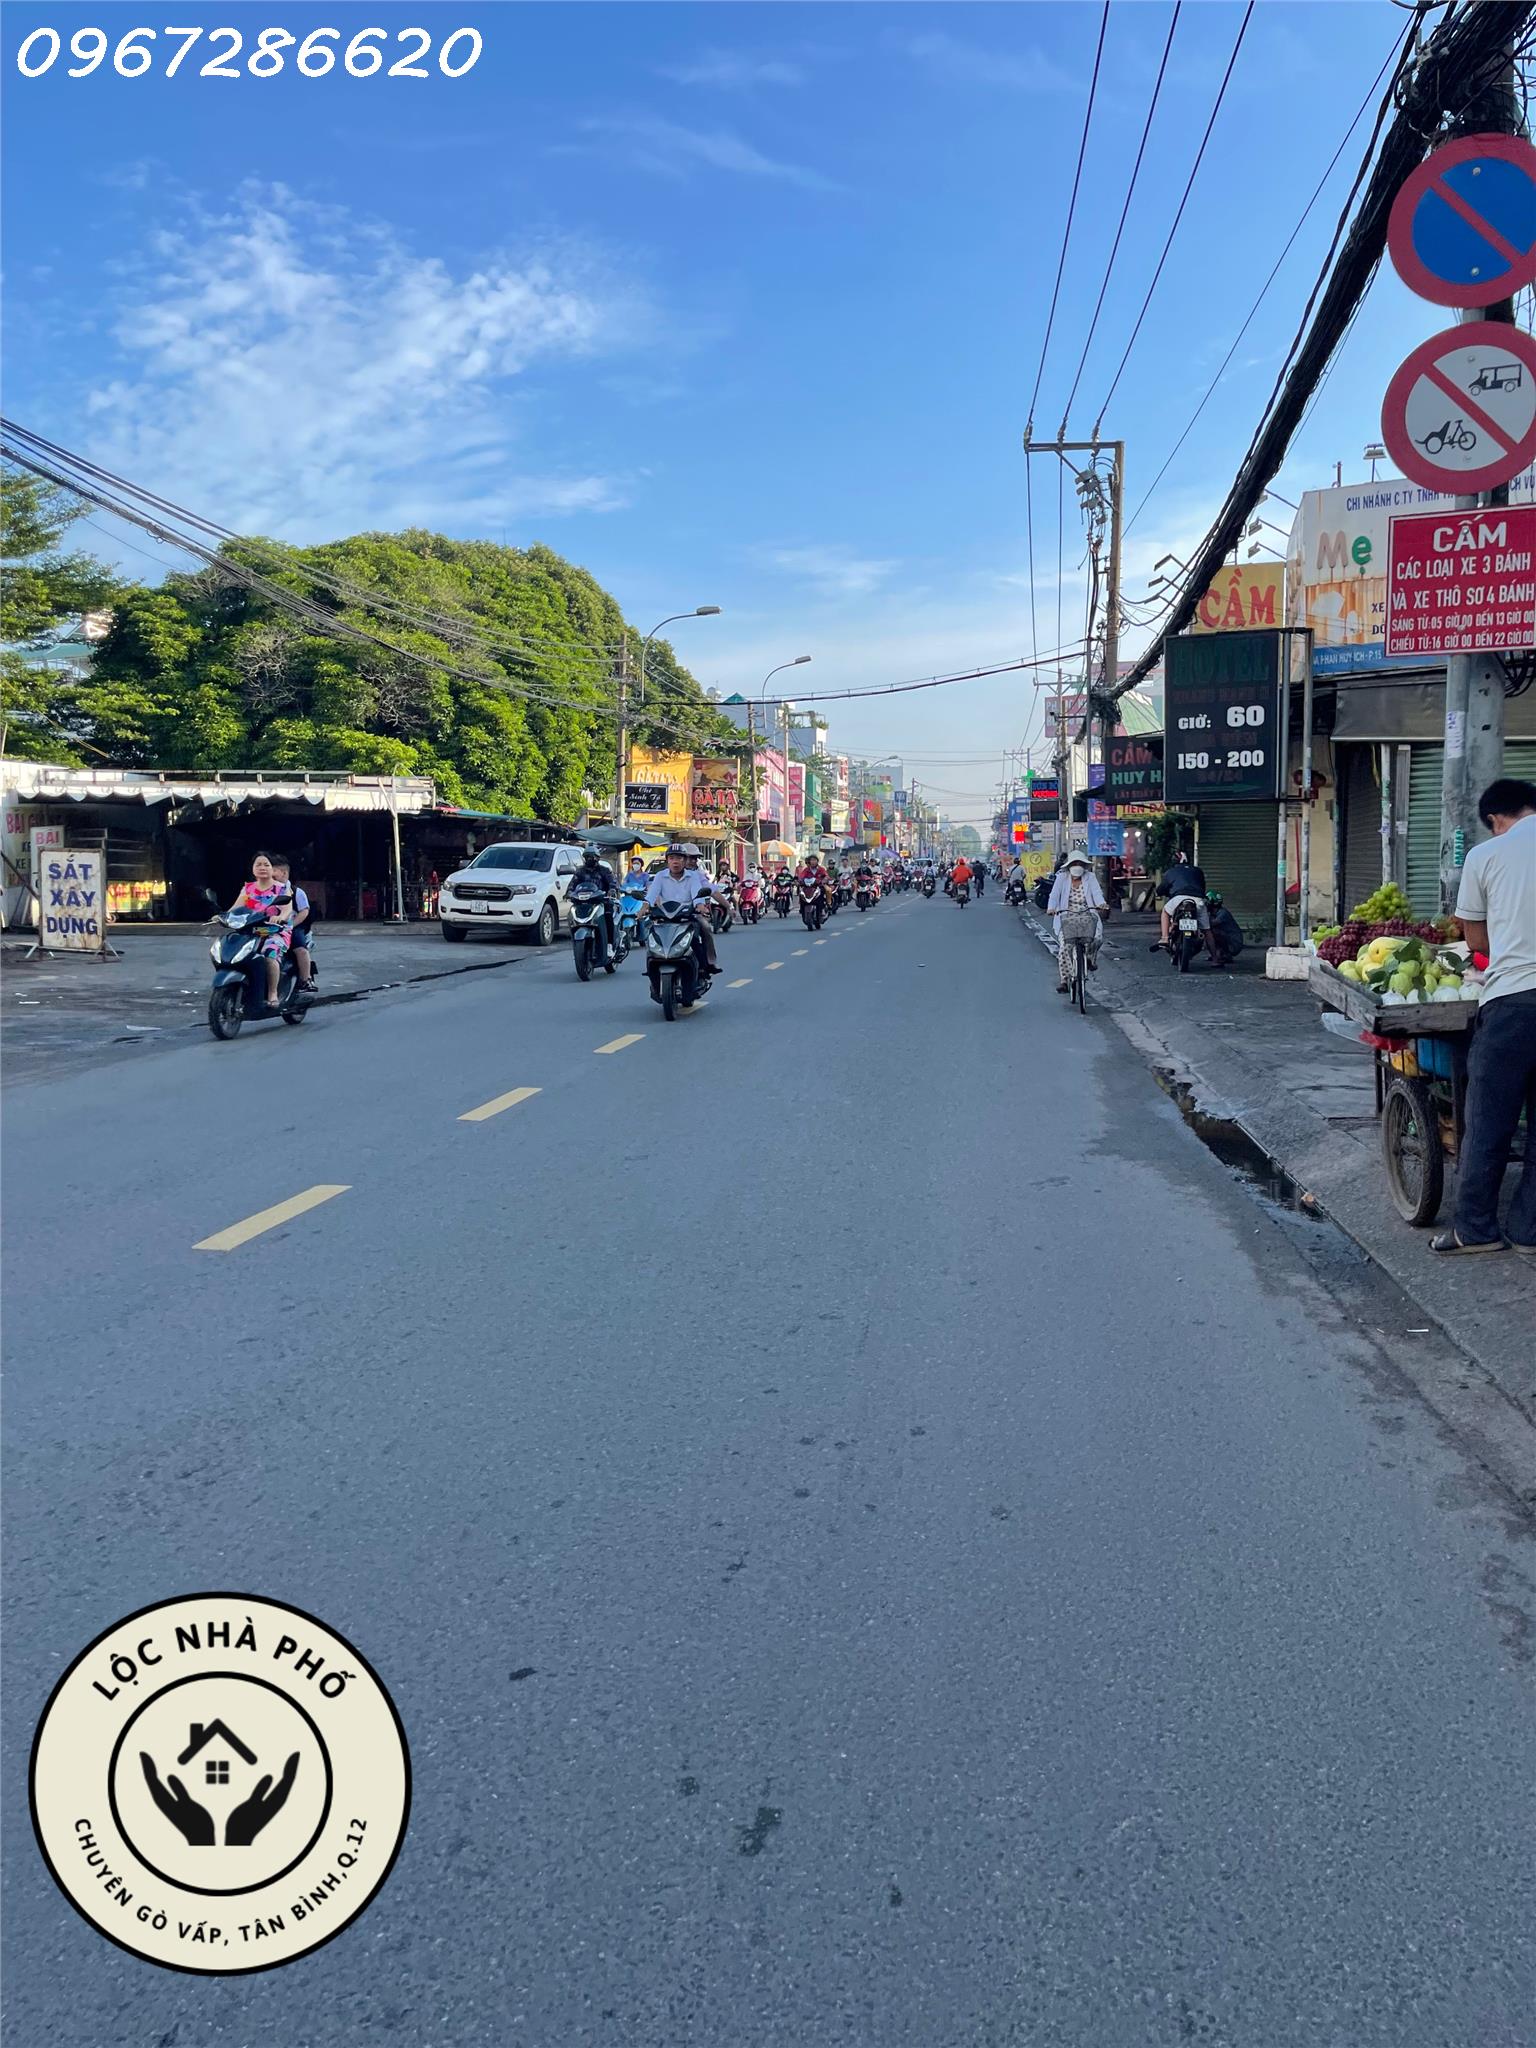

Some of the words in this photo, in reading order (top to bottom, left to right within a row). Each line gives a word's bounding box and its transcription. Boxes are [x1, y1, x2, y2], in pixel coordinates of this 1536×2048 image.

[1346, 497, 1361, 511] CHI
[1363, 491, 1391, 509] NHÁNH
[1432, 513, 1508, 553] CẤM
[1317, 530, 1373, 575] Mẹ
[1397, 556, 1421, 580] CÁC
[1426, 558, 1454, 580] LOẠI
[1461, 556, 1477, 575] XE
[1482, 555, 1491, 574] 3
[1495, 548, 1531, 573] BÁNH
[1199, 568, 1276, 628] CẦM
[1392, 587, 1407, 610] VÀ
[1413, 590, 1430, 609] XE
[1436, 584, 1461, 608] THÔ
[1466, 586, 1485, 606] SƠ
[1486, 585, 1495, 604] 4
[1499, 578, 1535, 603] BÁNH
[1391, 613, 1414, 632] SÁNG
[1495, 611, 1505, 625] 13
[1507, 607, 1522, 624] GIỜ
[1523, 609, 1535, 623] 00
[1444, 631, 1461, 648] GIỜ
[1461, 634, 1473, 647] 00
[1494, 630, 1506, 645] 22
[1507, 628, 1521, 644] GIỜ
[1523, 630, 1534, 643] 00
[1173, 638, 1269, 686] HOTEL
[1178, 713, 1211, 730] GIỜ:
[1226, 705, 1265, 728] 60
[1178, 752, 1209, 770] 150
[1227, 749, 1265, 768] 200
[1112, 771, 1145, 785] HUY
[49, 854, 92, 880] SẮT
[51, 886, 96, 907] XÂY
[47, 914, 98, 938] DỰNG
